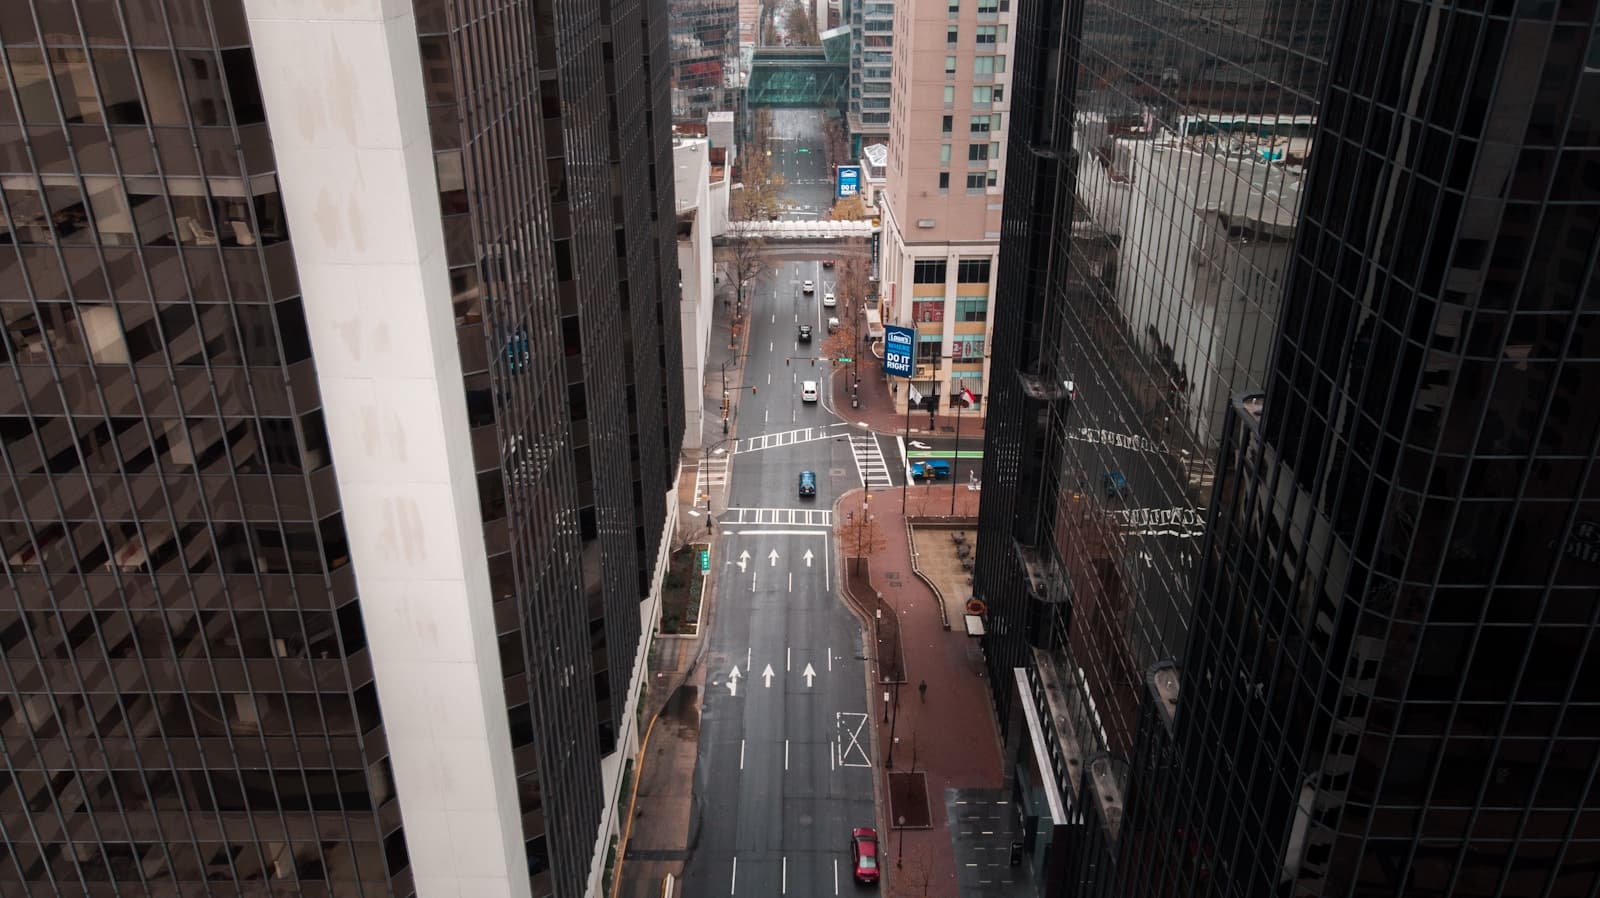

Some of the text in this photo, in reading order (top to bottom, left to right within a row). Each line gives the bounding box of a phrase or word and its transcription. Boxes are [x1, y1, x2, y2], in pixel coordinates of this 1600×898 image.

[887, 353, 910, 364] DO IT
[887, 362, 910, 371] RIGHT
